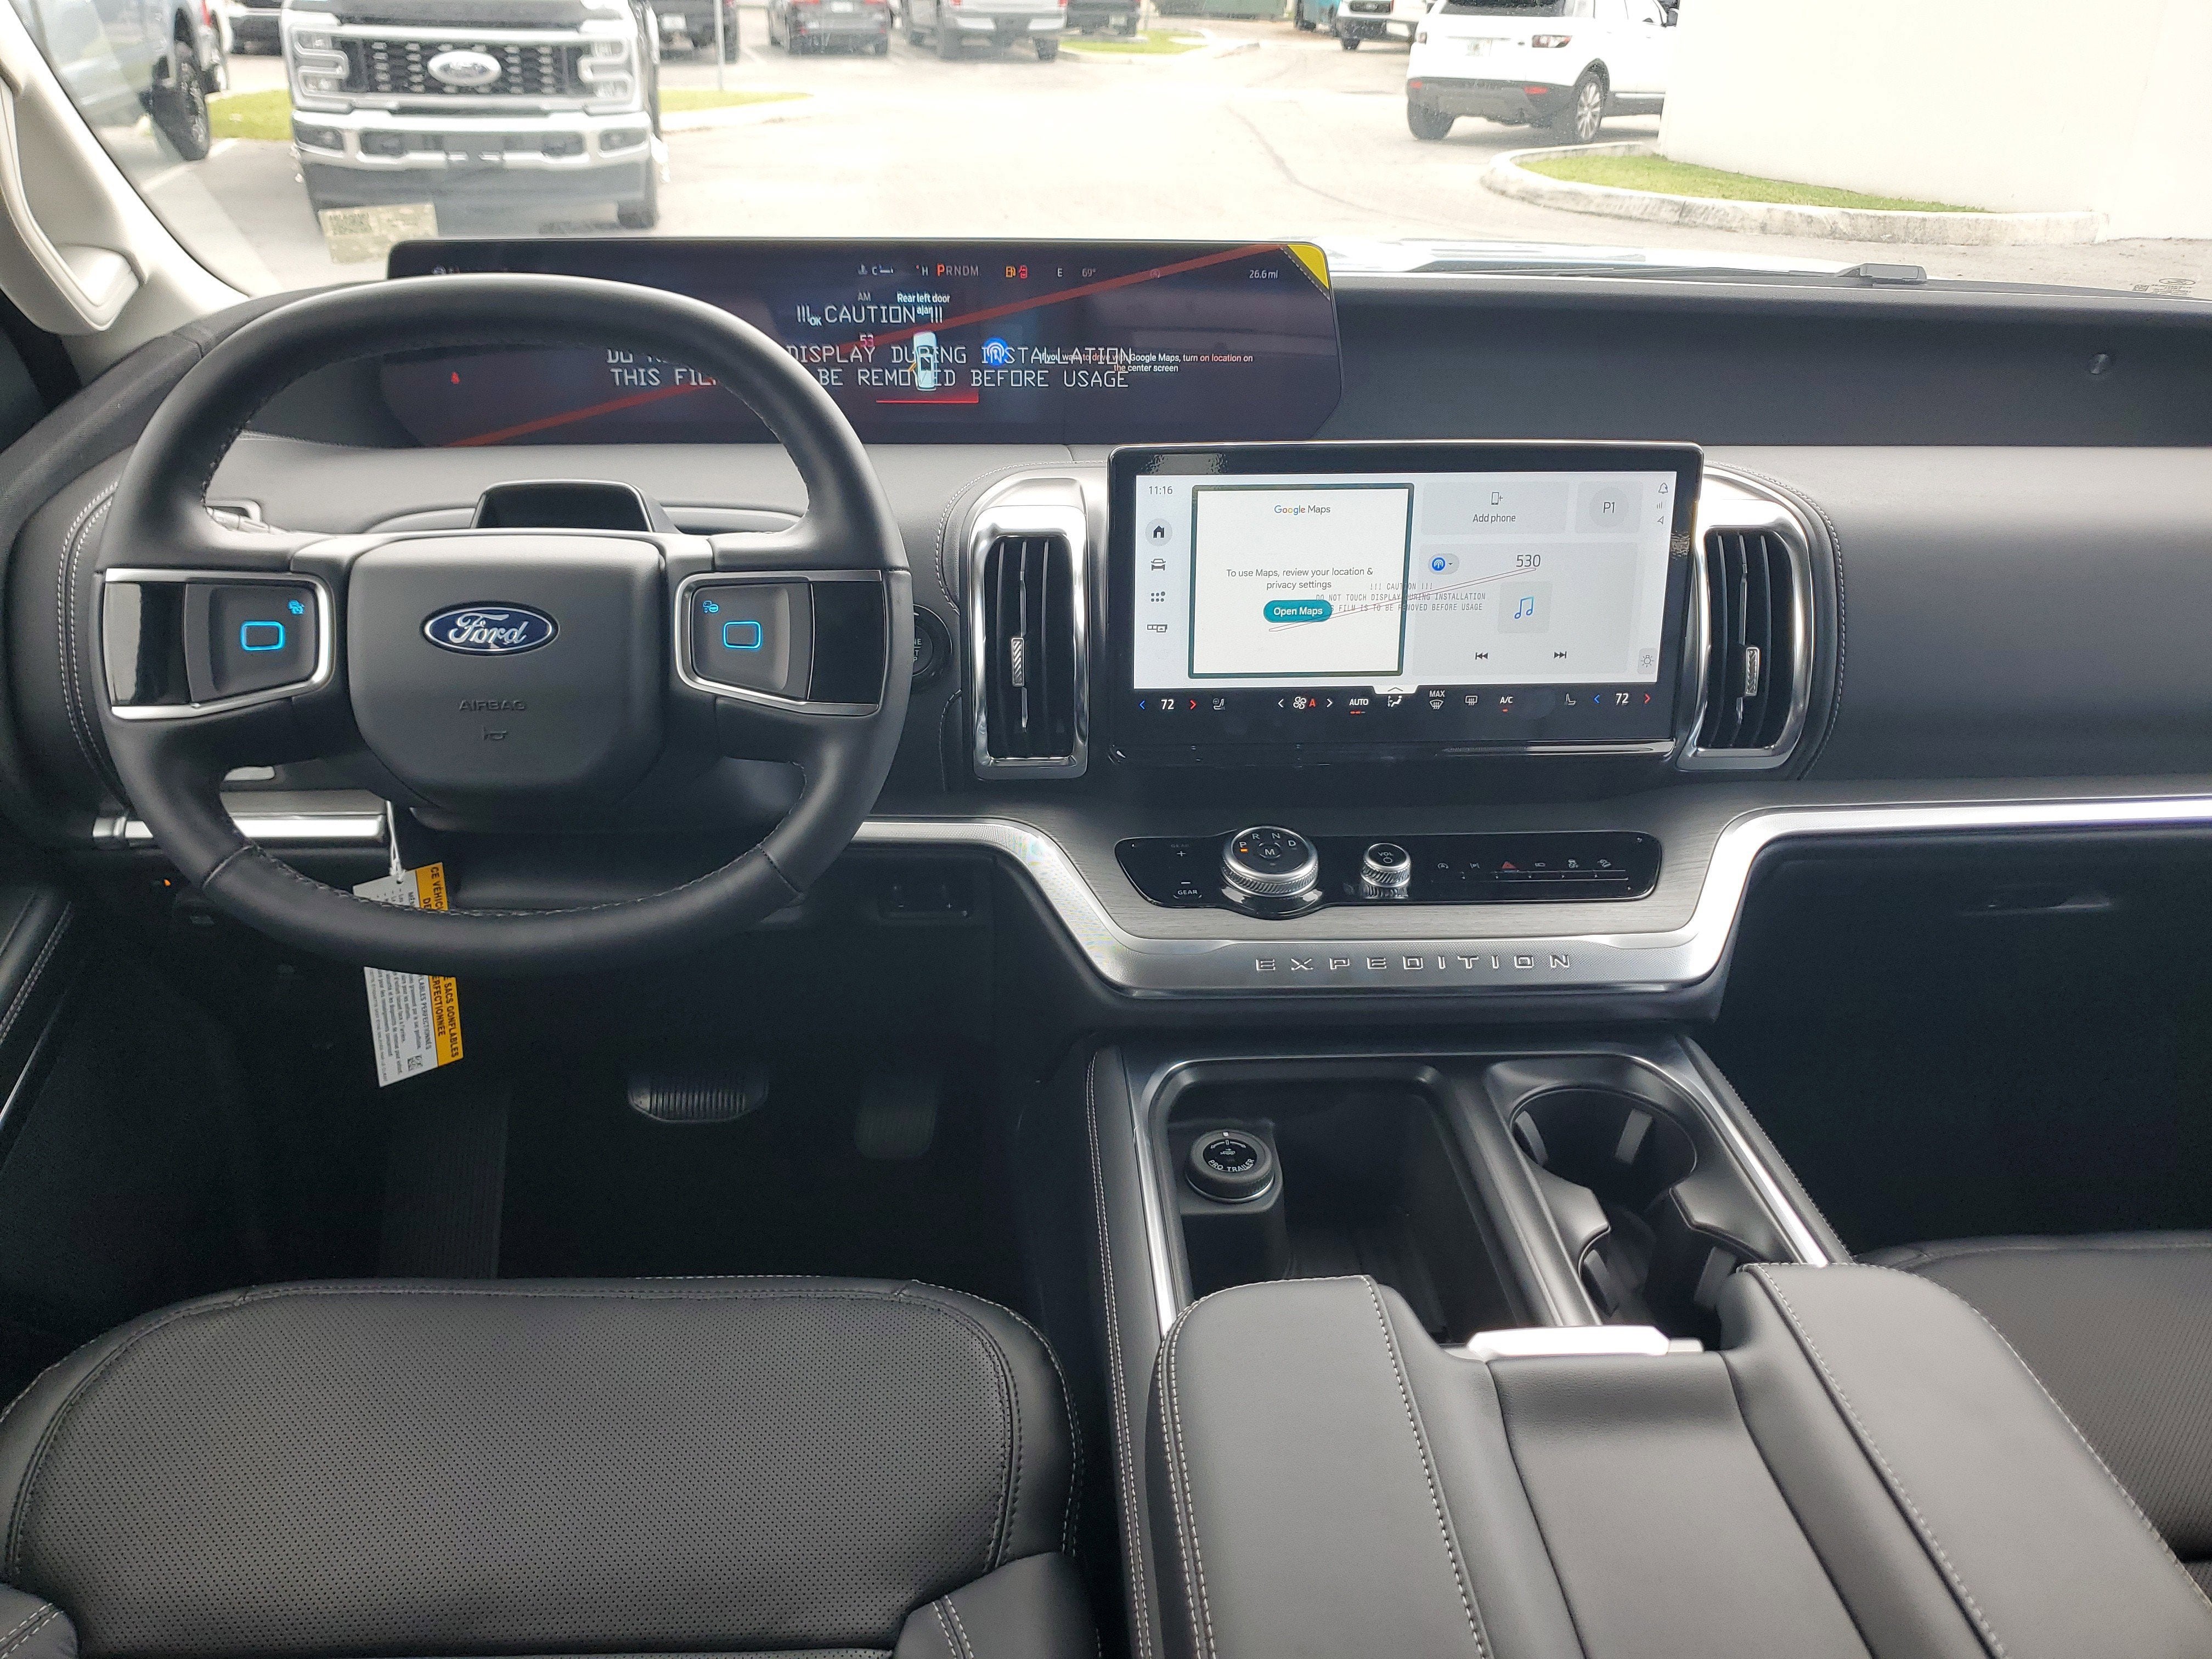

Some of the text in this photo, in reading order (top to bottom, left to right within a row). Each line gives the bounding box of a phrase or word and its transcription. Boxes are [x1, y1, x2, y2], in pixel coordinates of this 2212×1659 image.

[896, 291, 950, 303] Rear left door
[825, 304, 916, 324] CAUTION
[810, 316, 822, 326] OK
[1130, 353, 1156, 363] Google
[1159, 354, 1181, 363] Maps,
[1211, 353, 1242, 362] location
[610, 368, 661, 386] THIS
[675, 369, 717, 386] FIL
[817, 368, 843, 386] BE
[970, 369, 1049, 387] BEFORE
[1064, 370, 1130, 388] USAGE
[1148, 486, 1173, 495] 11:16
[1274, 505, 1331, 515] Google Maps
[1602, 501, 1615, 514] P1
[1472, 514, 1516, 523] Add phone
[1516, 554, 1541, 568] 530
[1226, 569, 1236, 577] To
[1255, 569, 1280, 578] Maps,
[1310, 569, 1330, 578] your
[1331, 567, 1365, 576] location
[1367, 567, 1373, 575] &
[1266, 580, 1332, 590] privacy settings
[1273, 607, 1297, 618] Open
[1299, 606, 1323, 617] Maps
[449, 612, 530, 645] Ford
[1161, 699, 1175, 710] 72
[1349, 698, 1369, 706] AUTO
[1500, 696, 1513, 704] A/C
[1615, 693, 1629, 705] 72
[1255, 955, 1570, 971] EXPEDITION
[1209, 1158, 1255, 1172] PRO TRAILER
